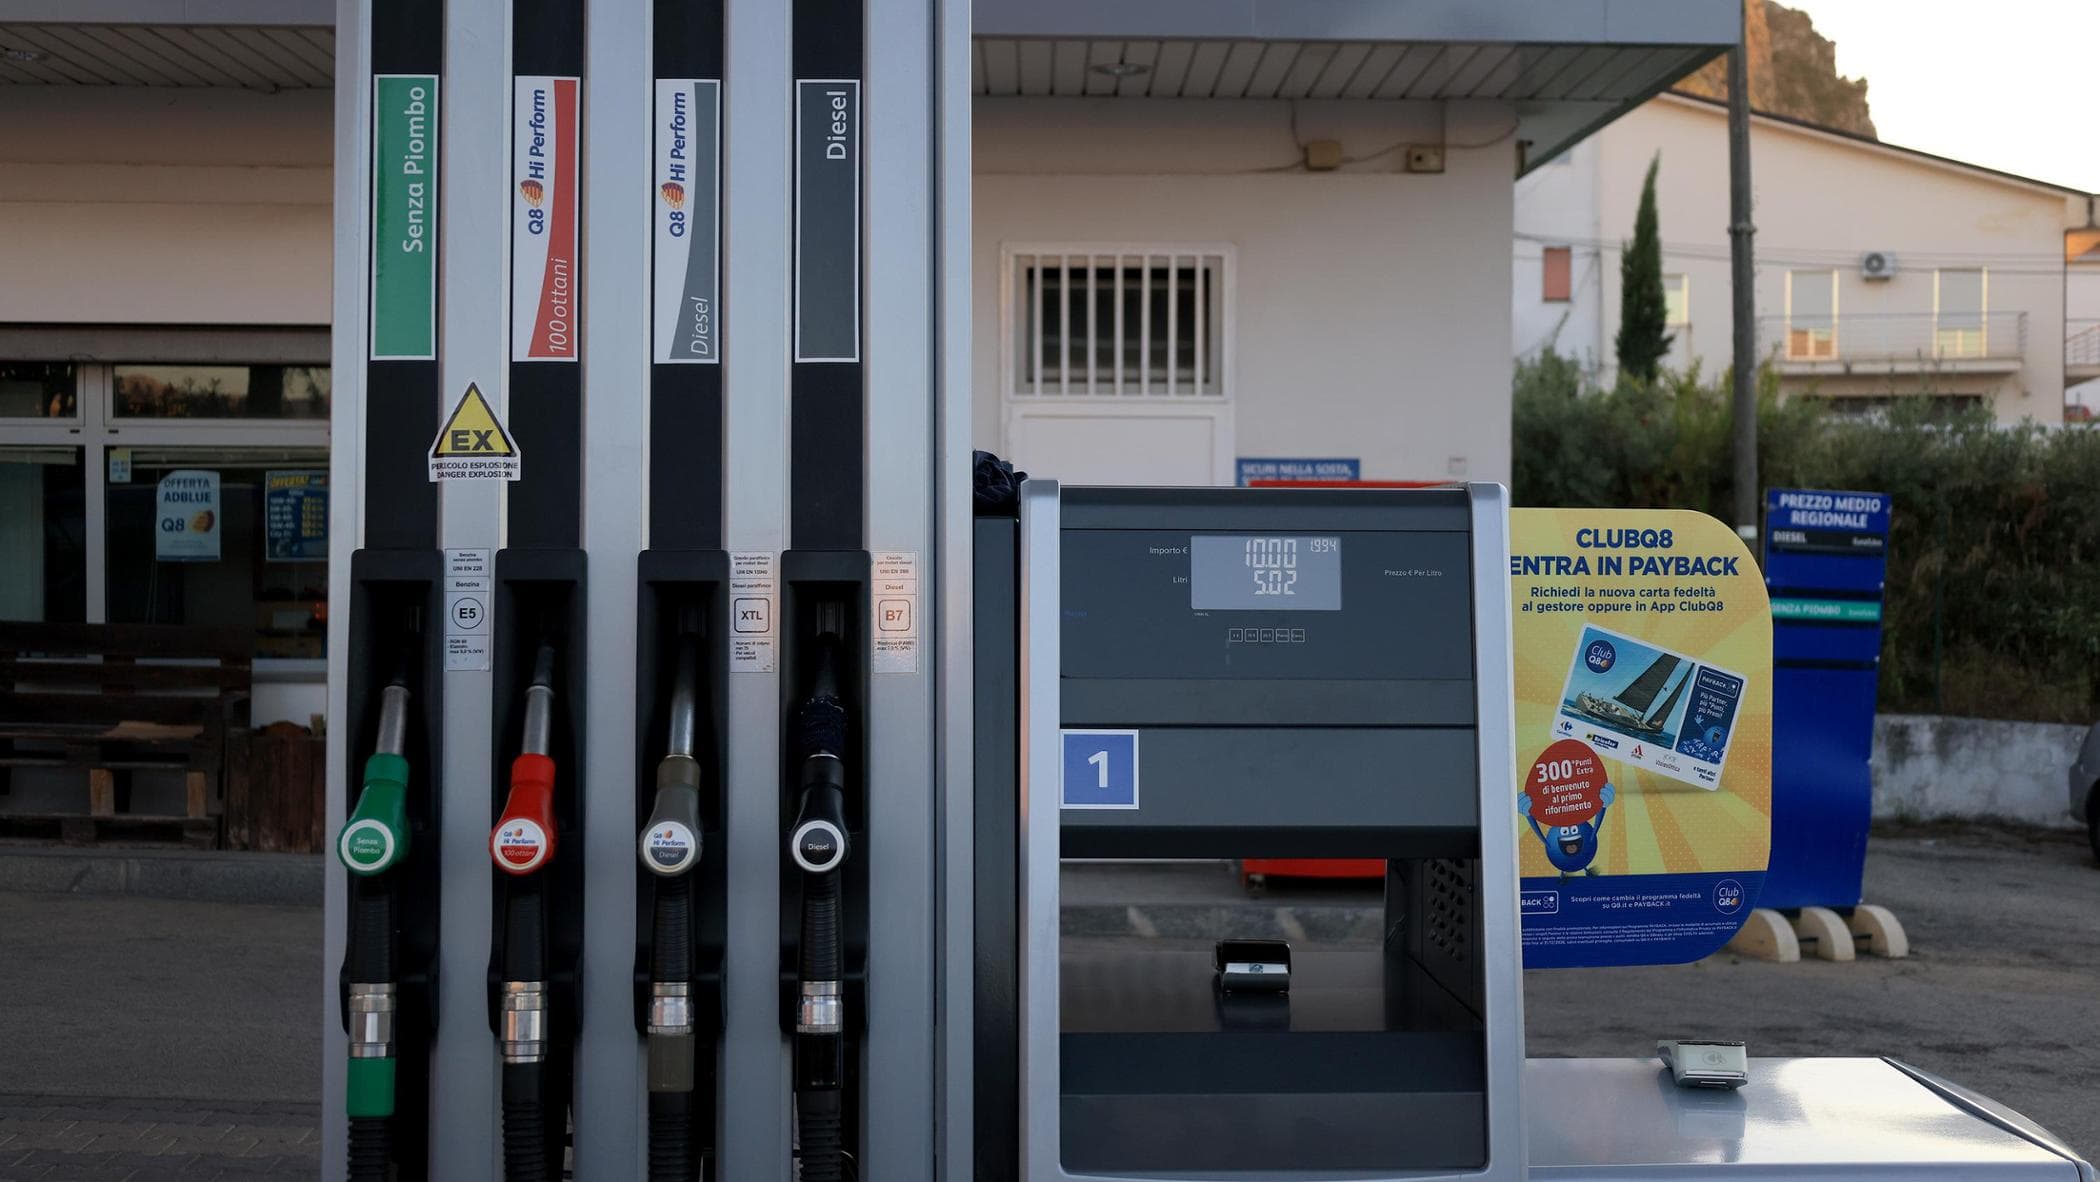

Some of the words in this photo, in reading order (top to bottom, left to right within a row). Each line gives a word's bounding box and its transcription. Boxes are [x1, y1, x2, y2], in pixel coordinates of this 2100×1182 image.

[529, 89, 546, 158] Perform
[670, 92, 687, 160] Perform
[826, 91, 847, 160] Diesel
[404, 86, 426, 175] Piombo
[529, 161, 545, 179] Hi
[670, 164, 686, 182] Hi
[402, 182, 424, 252] Senza
[528, 208, 544, 235] Q8
[669, 210, 686, 238] Q8
[690, 296, 709, 356] Diesel
[451, 430, 494, 451] EX
[432, 462, 468, 470] PERICOLO
[470, 462, 518, 470] ESPLOSIONE
[437, 470, 466, 478] DANGER
[468, 470, 512, 478] EXPLOSION
[164, 478, 210, 488] OFFERTA
[164, 492, 212, 504] ADBLUE
[1780, 493, 1833, 510] PREZZO
[1835, 496, 1881, 512] MEDIO
[162, 518, 185, 533] Q8
[1790, 510, 1868, 528] REGIONALE
[1576, 528, 1674, 549] CLUBQ8
[1773, 530, 1807, 543] DIESEL
[1150, 546, 1181, 554] Importo
[1182, 546, 1188, 554] €
[1246, 538, 1297, 568] 10.00
[1510, 556, 1591, 576] ENTRA
[1597, 556, 1622, 576] IN
[1628, 556, 1739, 576] PAYBACK
[1172, 576, 1188, 584] Litri
[1253, 570, 1297, 595] 5.02
[1530, 586, 1580, 598] Richiedi
[1584, 586, 1595, 598] la
[1600, 588, 1636, 598] nuova
[1639, 588, 1670, 598] carta
[1674, 586, 1716, 598] fedeltà
[459, 608, 477, 619] E5
[1522, 601, 1532, 612] al
[1536, 603, 1584, 614] gestore
[1588, 604, 1633, 614] oppure
[1636, 601, 1646, 612] in
[1650, 602, 1676, 614] App
[1679, 601, 1724, 612] ClubQ8
[741, 610, 763, 620] XTL
[886, 610, 903, 621] B7
[1592, 646, 1612, 659] Club
[1589, 656, 1602, 665] Q8
[1087, 750, 1108, 788] 1
[1536, 760, 1572, 782] 300
[1576, 767, 1594, 776] Extra
[1542, 786, 1550, 794] di
[1551, 781, 1590, 793] benvenuto
[1552, 796, 1560, 804] al
[1560, 793, 1582, 804] primo
[1545, 801, 1592, 815] rifornimento
[808, 842, 830, 850] Diesel
[1642, 894, 1678, 902] programma
[1719, 887, 1739, 897] Club
[1719, 898, 1730, 906] Q8
